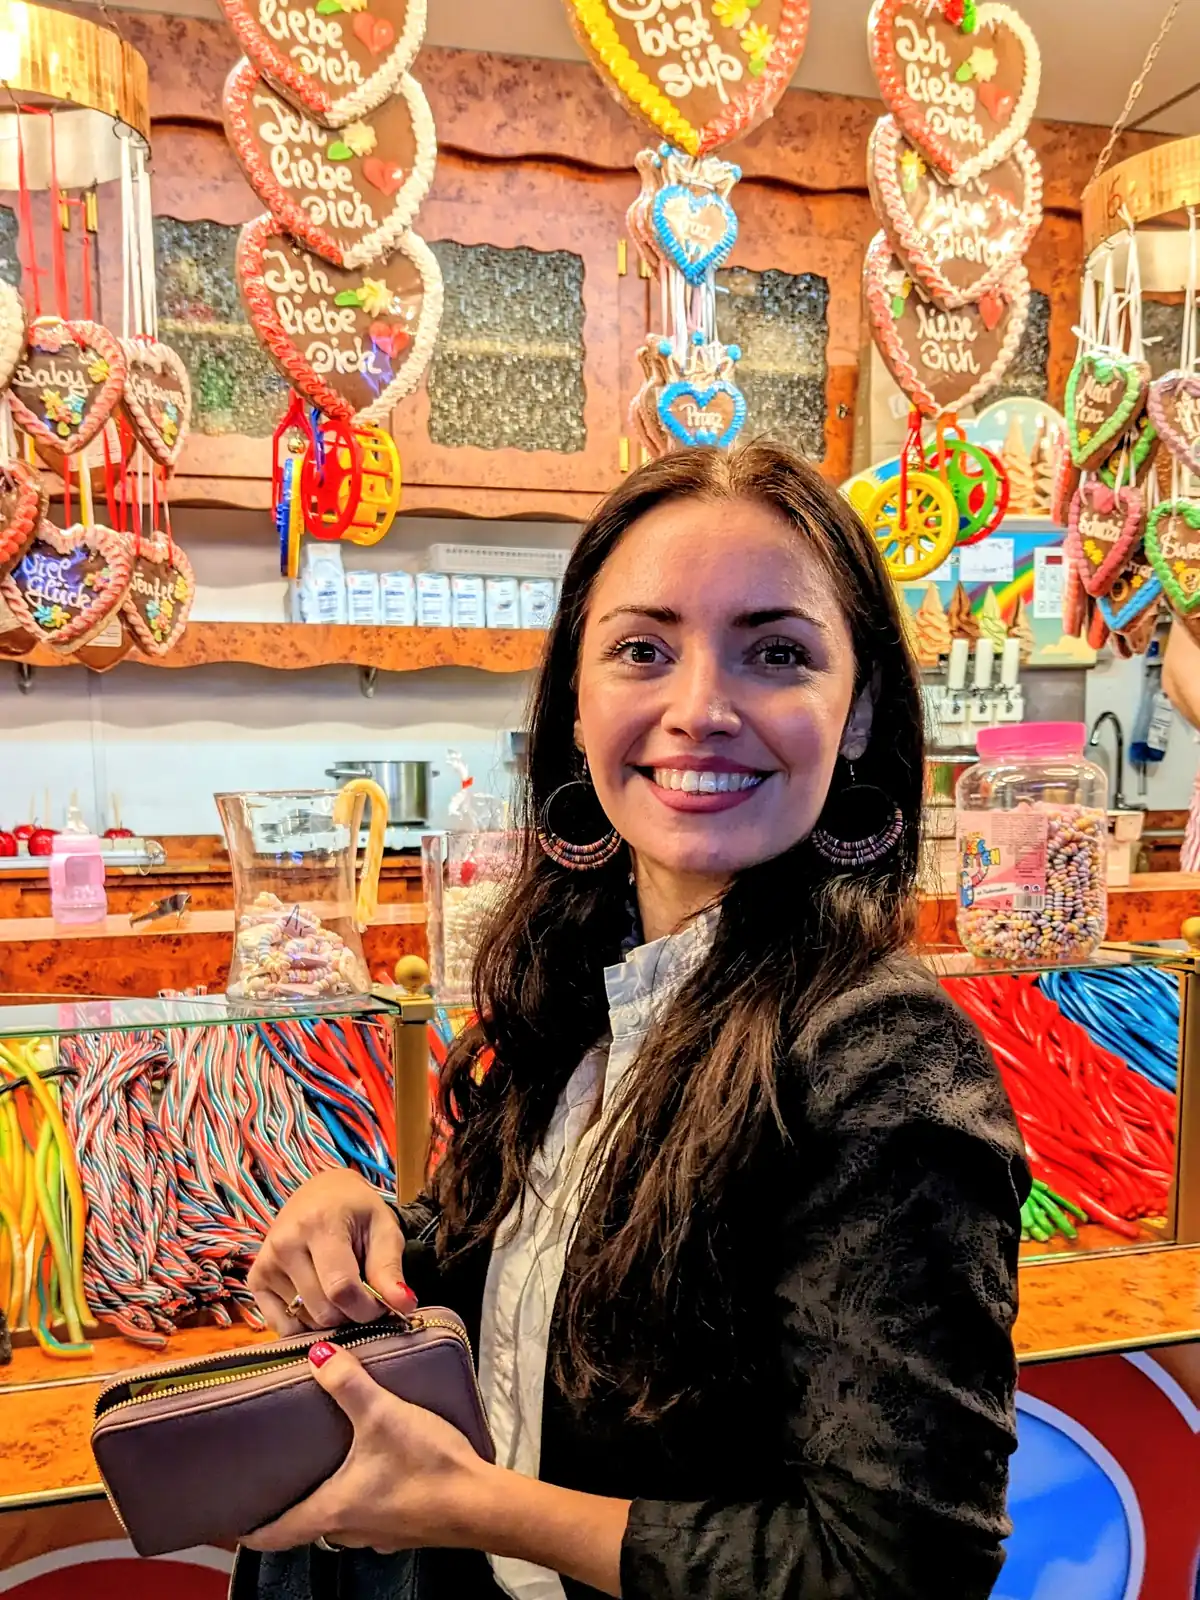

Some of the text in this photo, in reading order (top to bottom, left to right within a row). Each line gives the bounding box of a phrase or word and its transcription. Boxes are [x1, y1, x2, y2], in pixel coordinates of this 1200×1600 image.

[634, 0, 714, 57] bist
[894, 15, 951, 68] Ich
[289, 46, 364, 85] Dich
[925, 105, 987, 147] Dich
[270, 143, 354, 192] liebe
[301, 190, 378, 228] Dich
[262, 248, 336, 295] Ich
[275, 294, 356, 335] liebe
[305, 336, 382, 374] Dich
[920, 340, 981, 375] Dich
[12, 361, 95, 397] Baby
[22, 554, 72, 582] Viel
[25, 576, 92, 609] Glück
